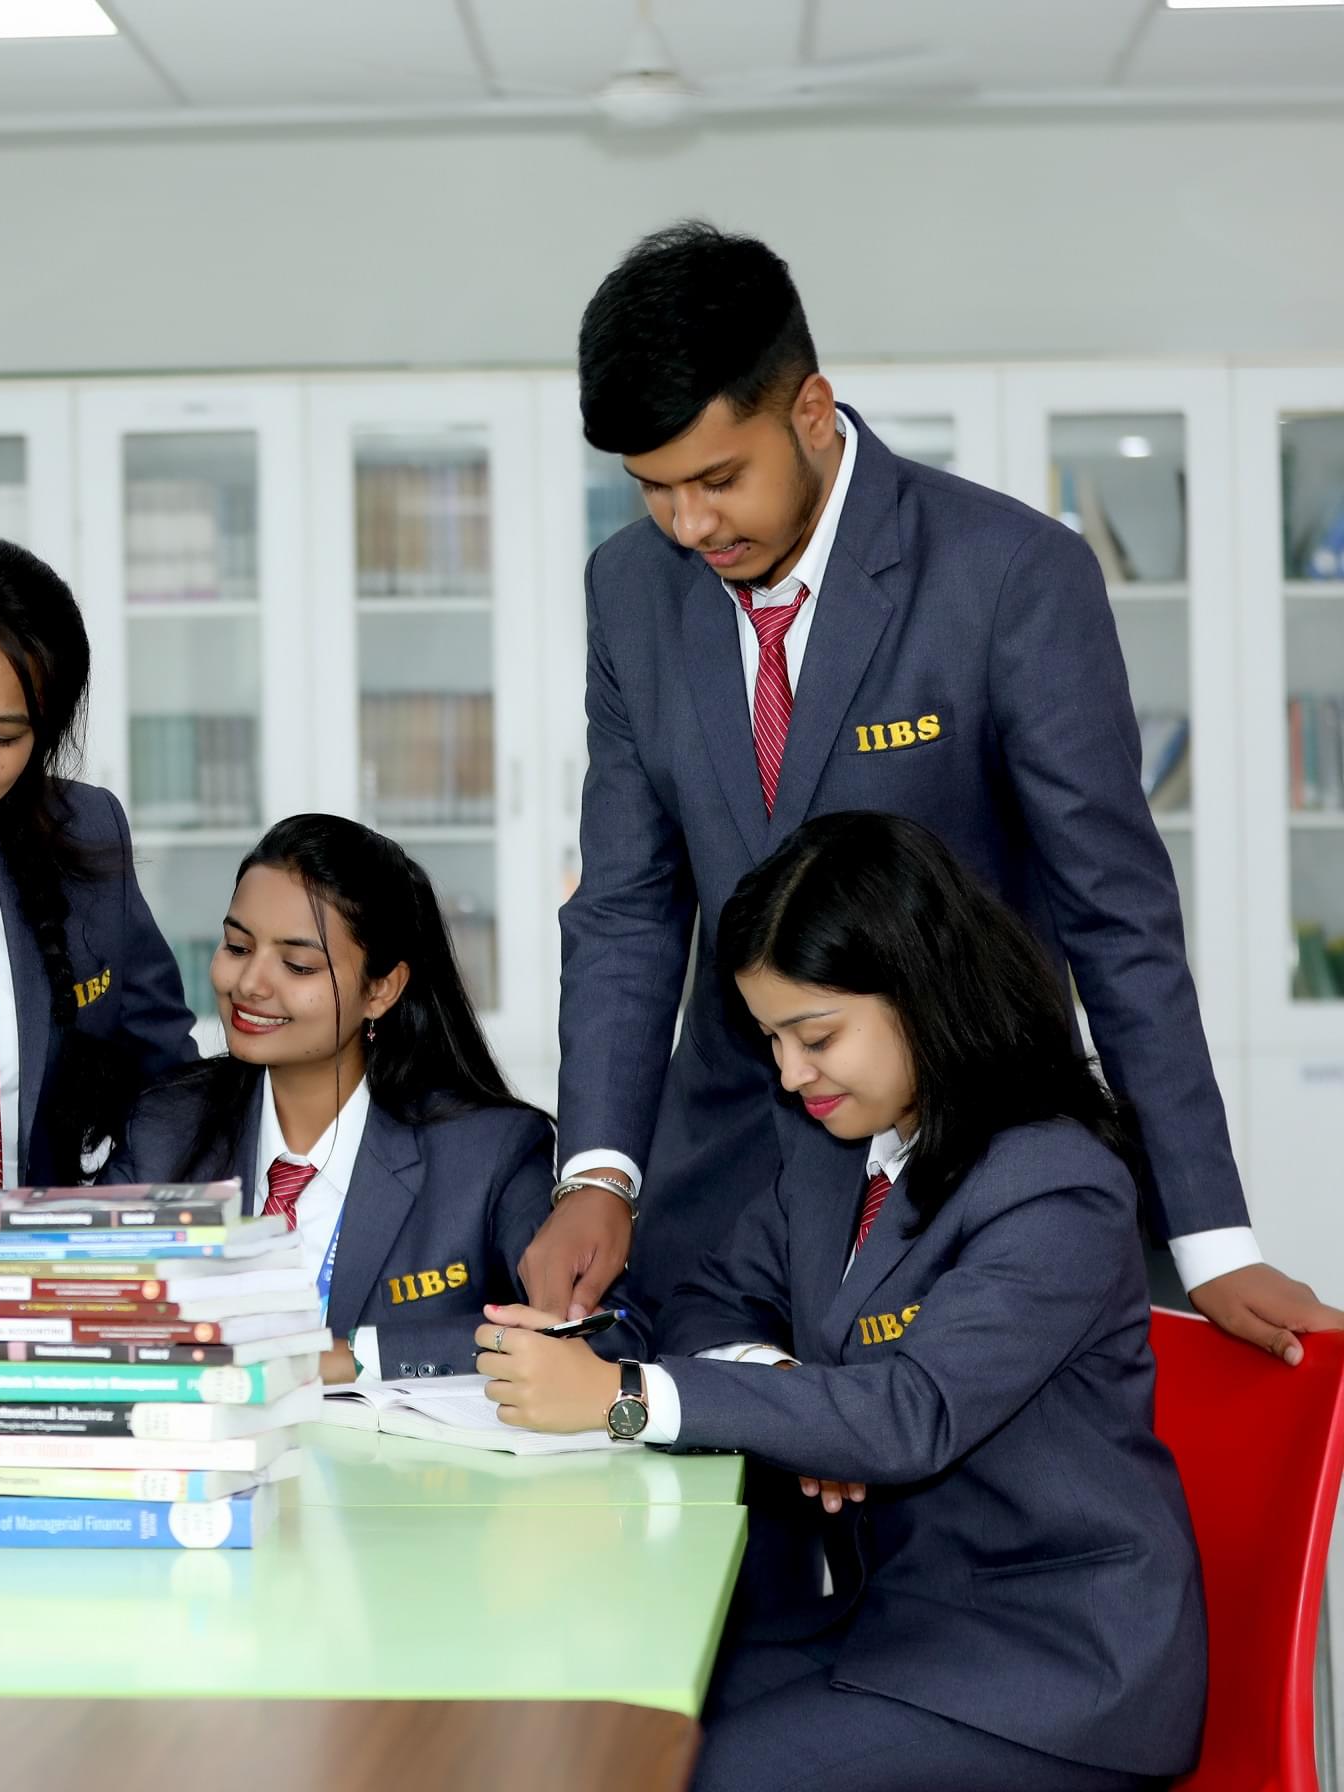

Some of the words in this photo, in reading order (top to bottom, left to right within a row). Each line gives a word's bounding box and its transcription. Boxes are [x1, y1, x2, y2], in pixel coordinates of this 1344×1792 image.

[855, 714, 941, 752] IIBS
[72, 968, 111, 1008] IBS
[388, 1263, 468, 1304] IIBS
[109, 1377, 179, 1393] Management
[57, 1405, 114, 1422] Behavior
[0, 1515, 14, 1531] of
[15, 1515, 81, 1534] Managerial
[85, 1515, 132, 1531] Finance
